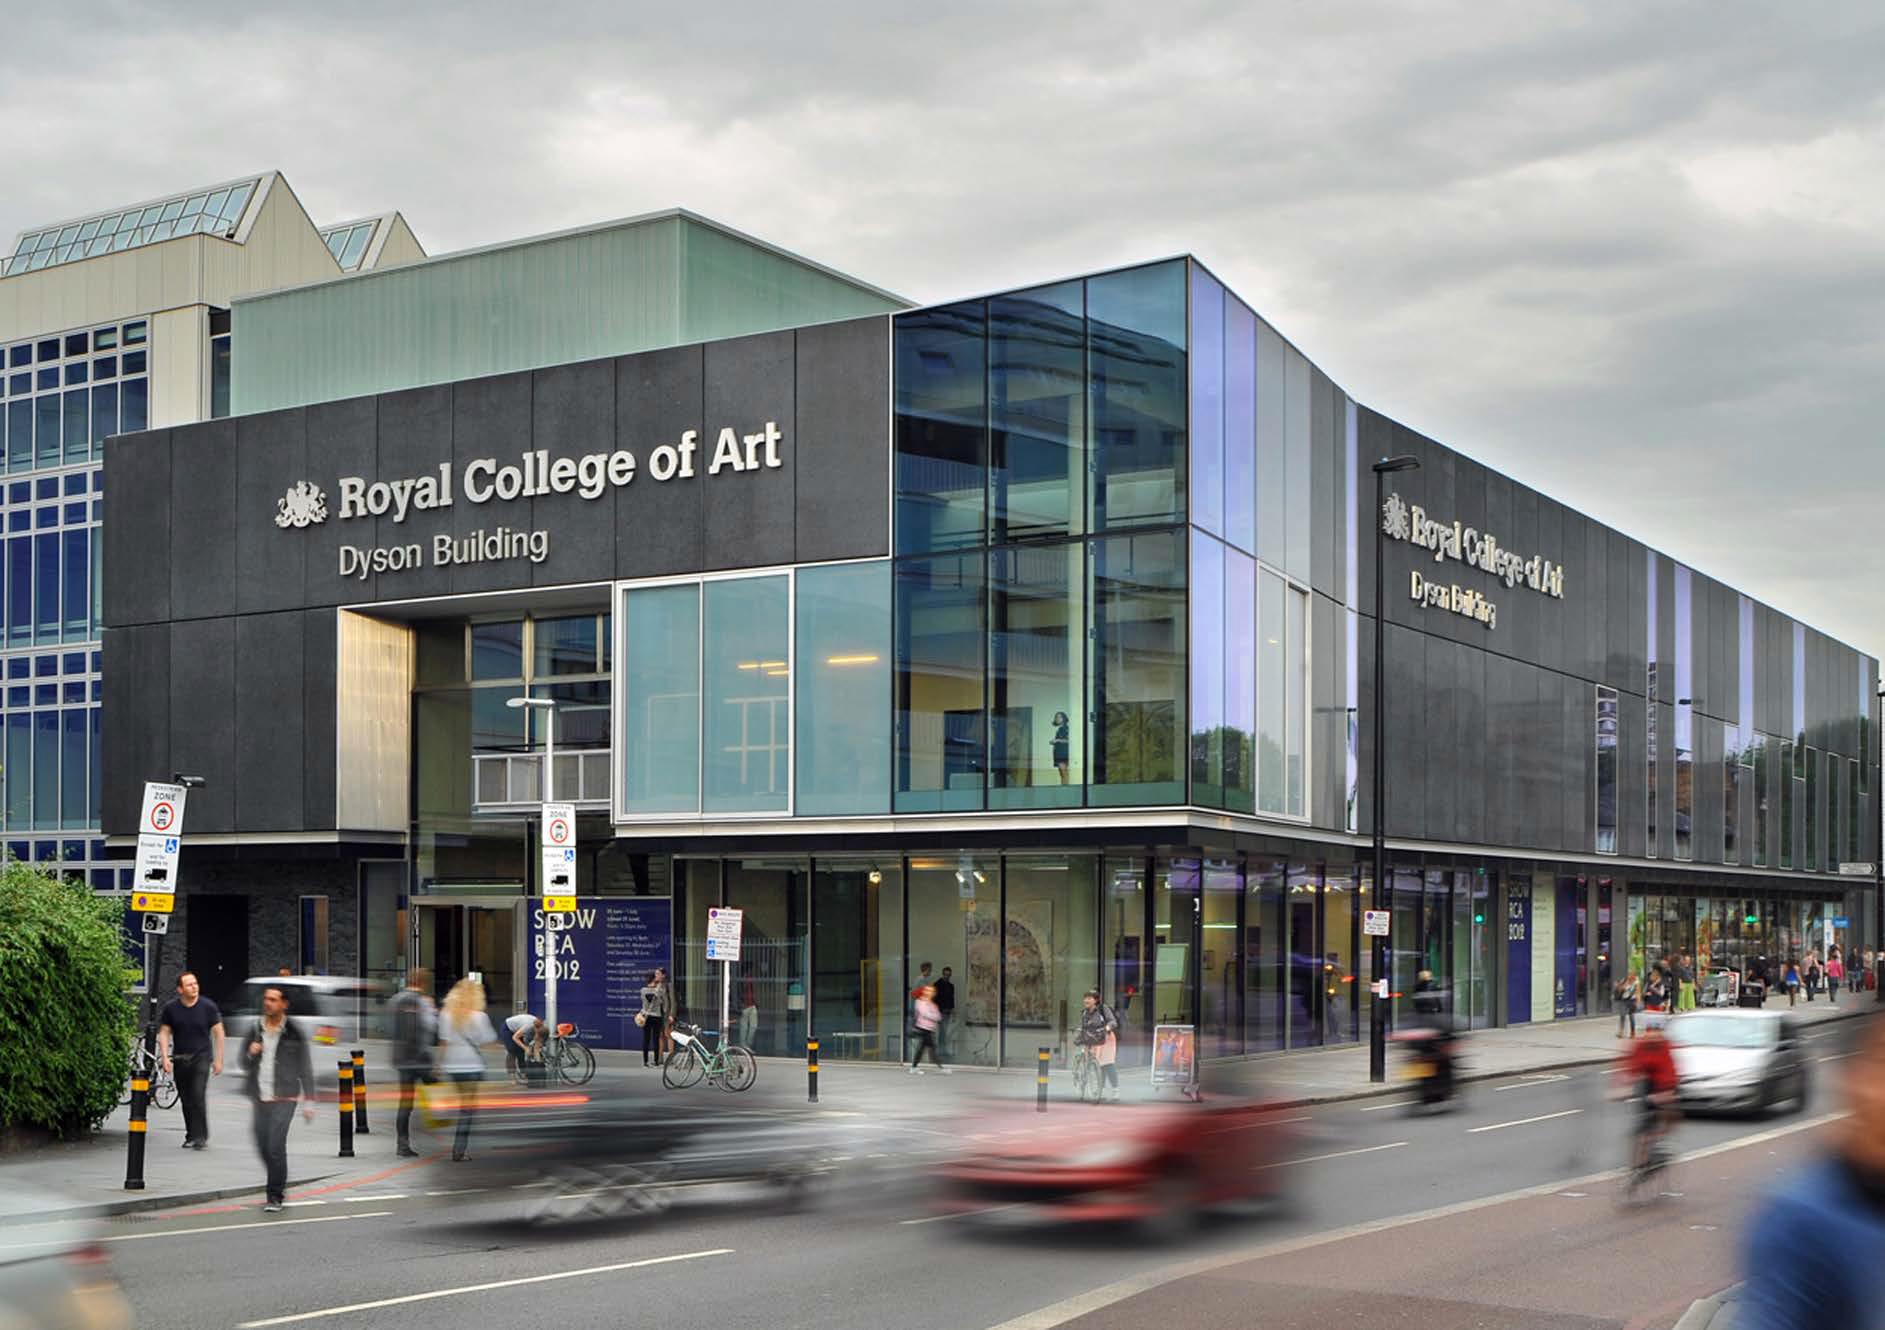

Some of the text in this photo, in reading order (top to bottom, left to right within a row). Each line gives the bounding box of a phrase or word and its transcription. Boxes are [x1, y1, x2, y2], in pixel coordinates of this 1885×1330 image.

[339, 421, 784, 522] Royal College of Art
[338, 529, 550, 581] Dyson Building
[1410, 505, 1564, 599] Royal College of Art
[1410, 571, 1496, 630] Dyson Building
[154, 792, 176, 802] ZONE
[534, 909, 596, 930] SOW
[1509, 901, 1523, 919] RCA
[1508, 923, 1525, 940] 2012
